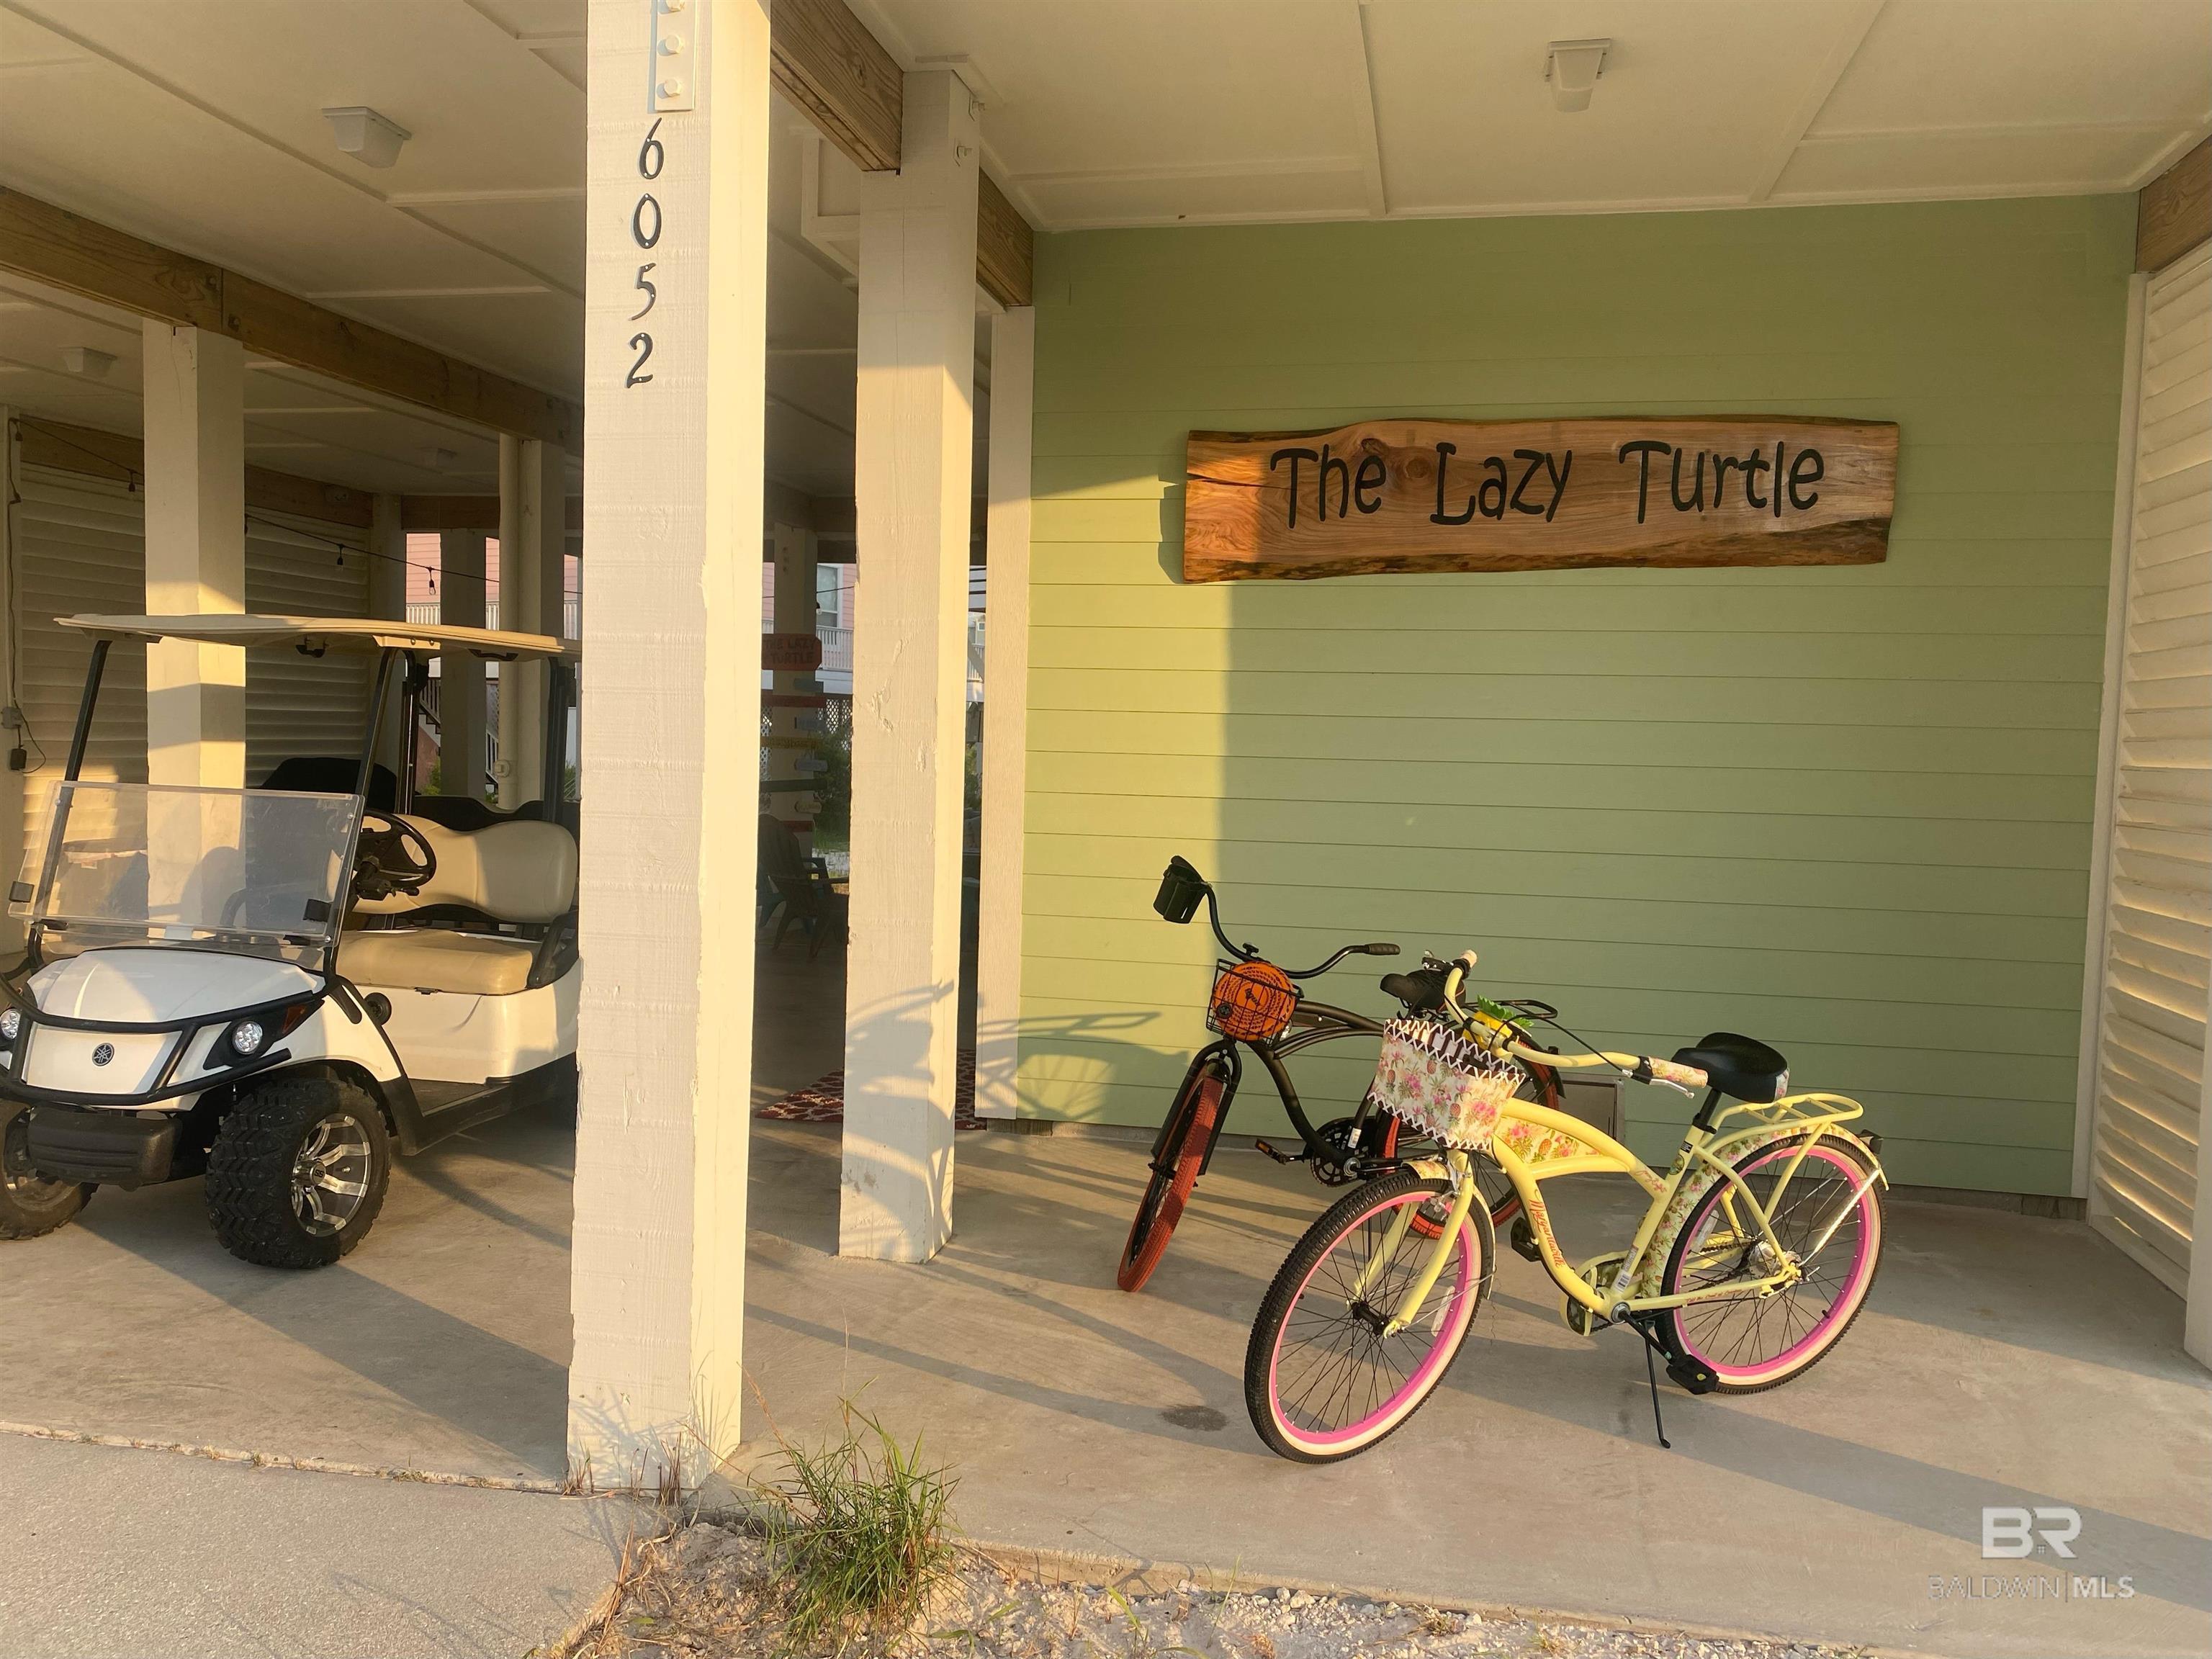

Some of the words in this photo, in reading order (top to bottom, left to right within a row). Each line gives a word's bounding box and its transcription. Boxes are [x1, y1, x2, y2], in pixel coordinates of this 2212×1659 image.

[626, 117, 665, 389] 6052
[1269, 443, 1388, 529] The
[1429, 441, 1573, 526] Lazy
[1618, 440, 1825, 525] Turtle
[770, 652, 814, 664] TURTLE
